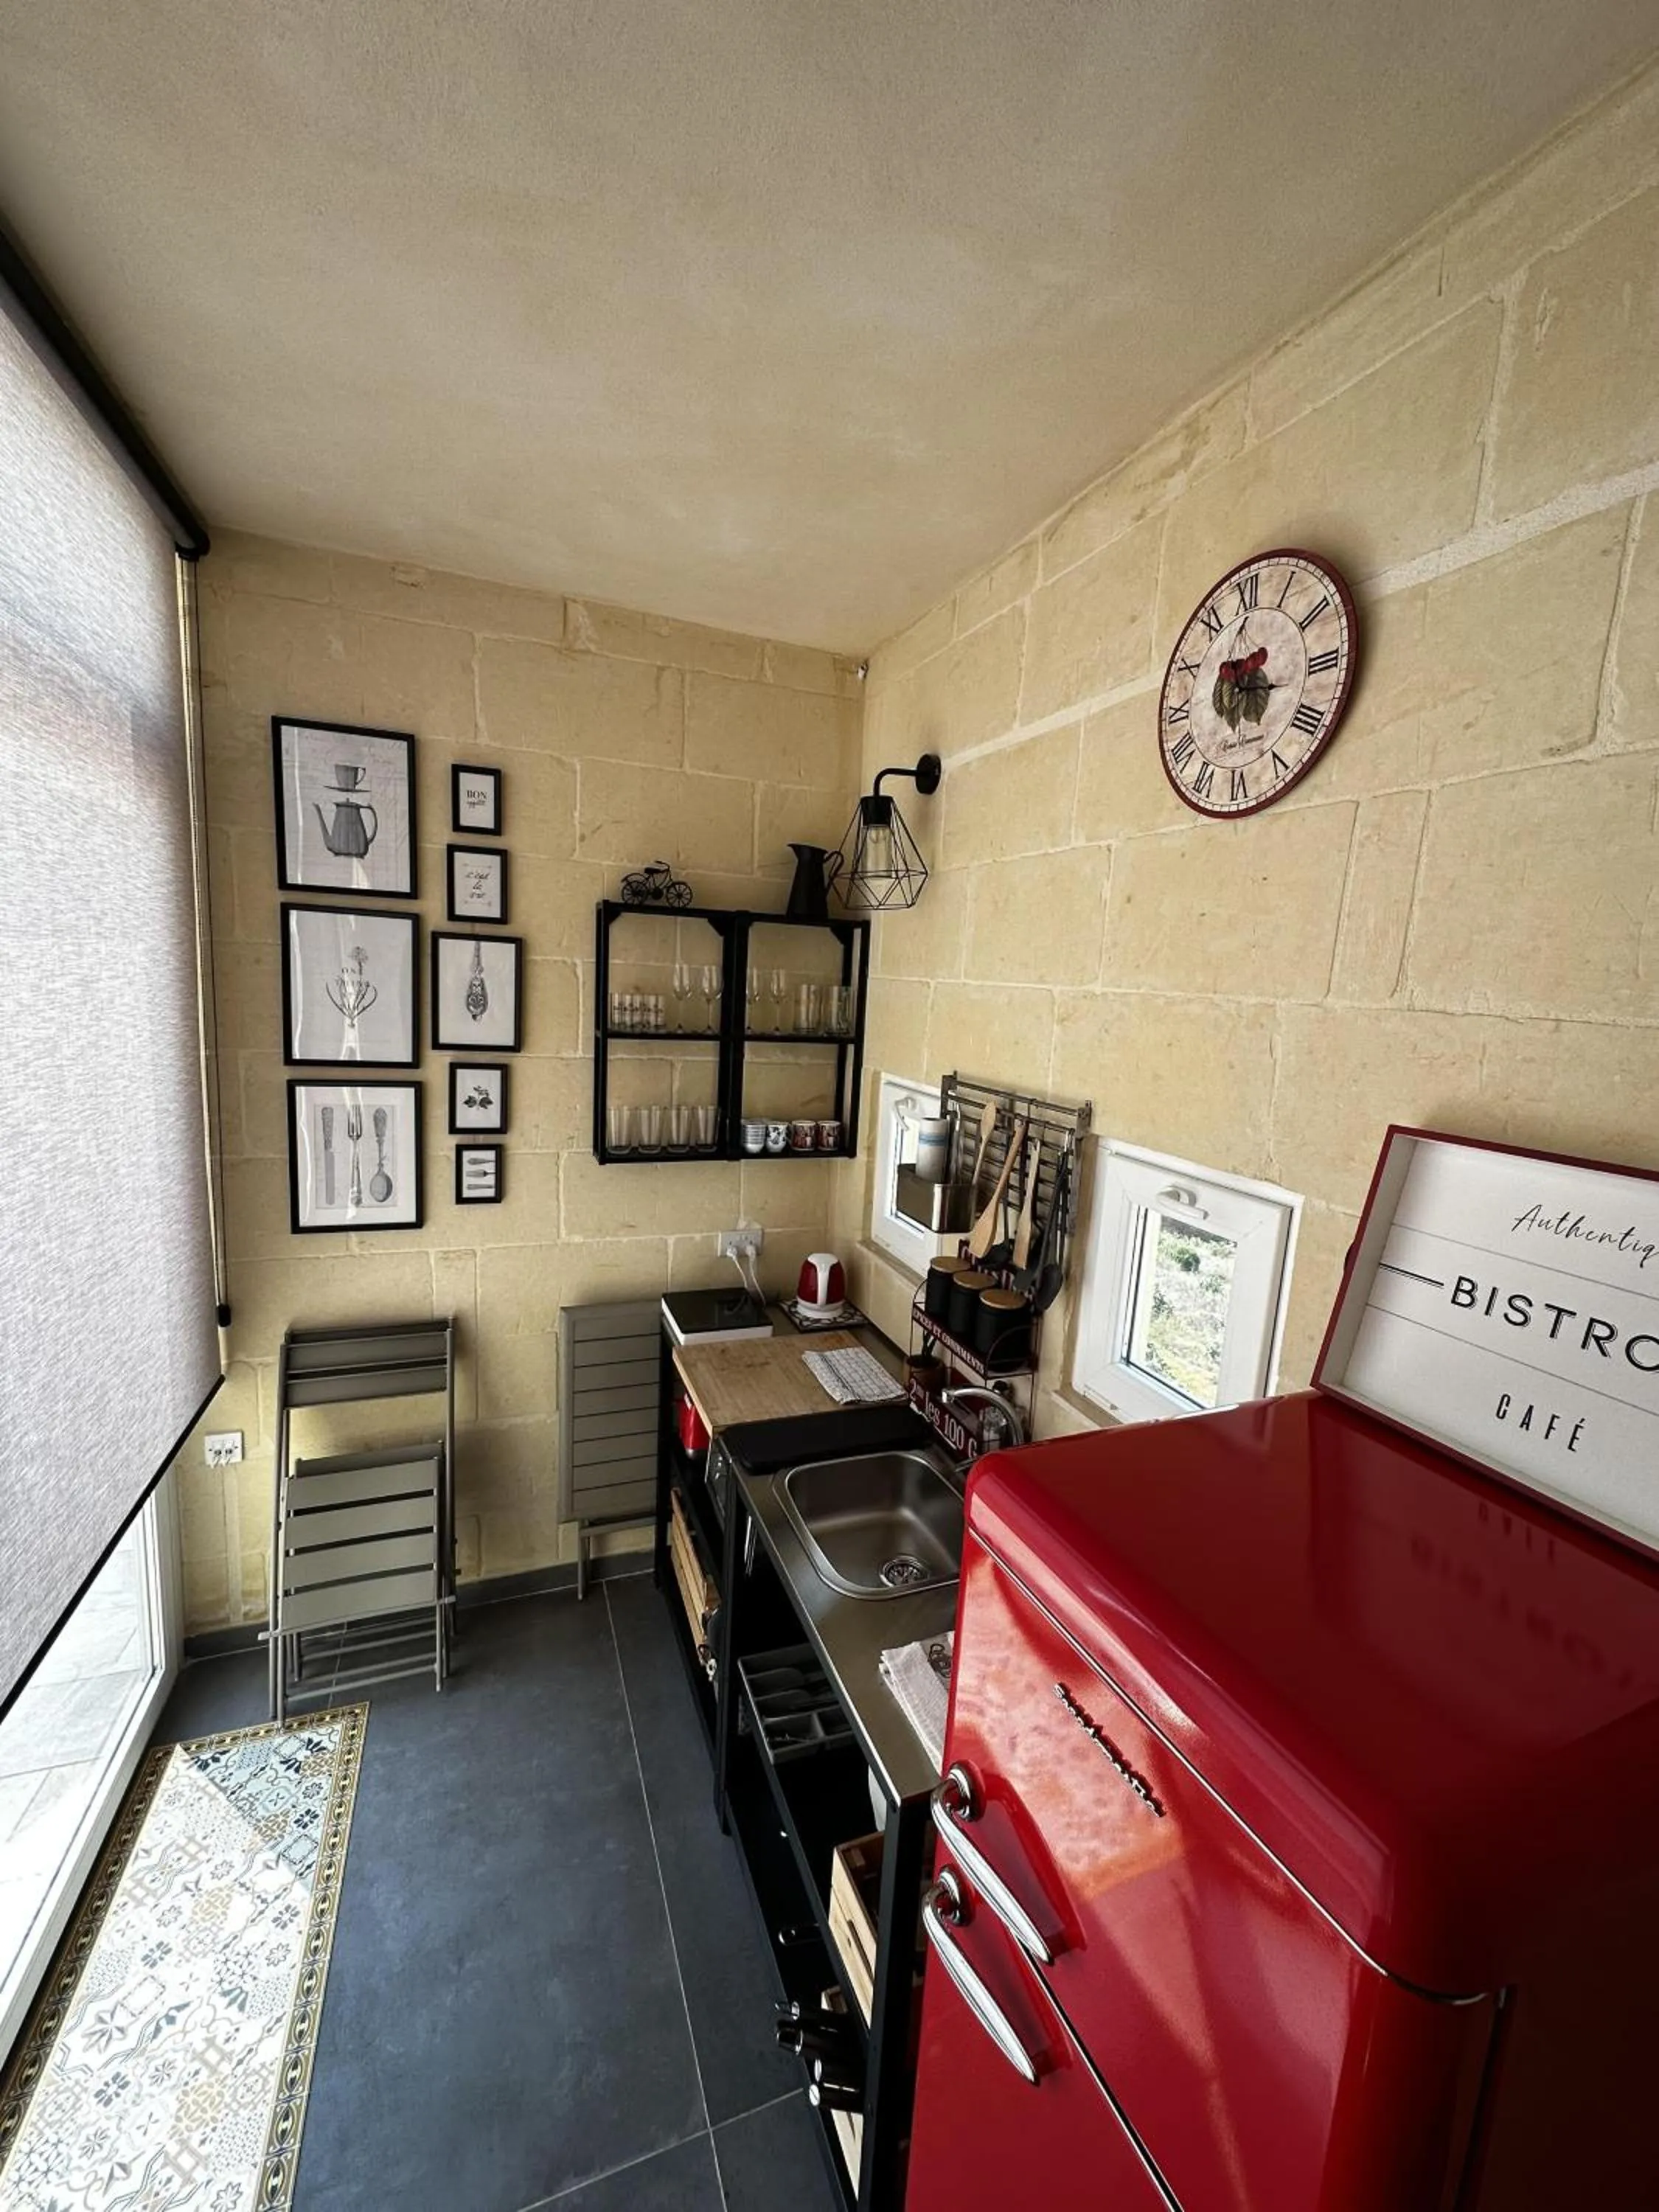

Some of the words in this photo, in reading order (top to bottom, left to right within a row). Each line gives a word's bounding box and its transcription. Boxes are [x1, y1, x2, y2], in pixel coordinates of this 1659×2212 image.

[1235, 573, 1259, 616] XII
[1277, 571, 1296, 608] I
[1200, 605, 1224, 642] XI
[1299, 595, 1330, 632] II
[1178, 658, 1200, 678] X
[1308, 647, 1339, 676] III
[1171, 731, 1194, 774] VIII
[1270, 748, 1290, 779] V
[467, 790, 487, 800] BON
[1192, 760, 1215, 799] VII
[1230, 769, 1248, 801] VI
[1450, 1276, 1659, 1373] BISTRO
[925, 1391, 941, 1426] les
[945, 1413, 964, 1450] 100
[1495, 1393, 1587, 1453] CAFÉ
